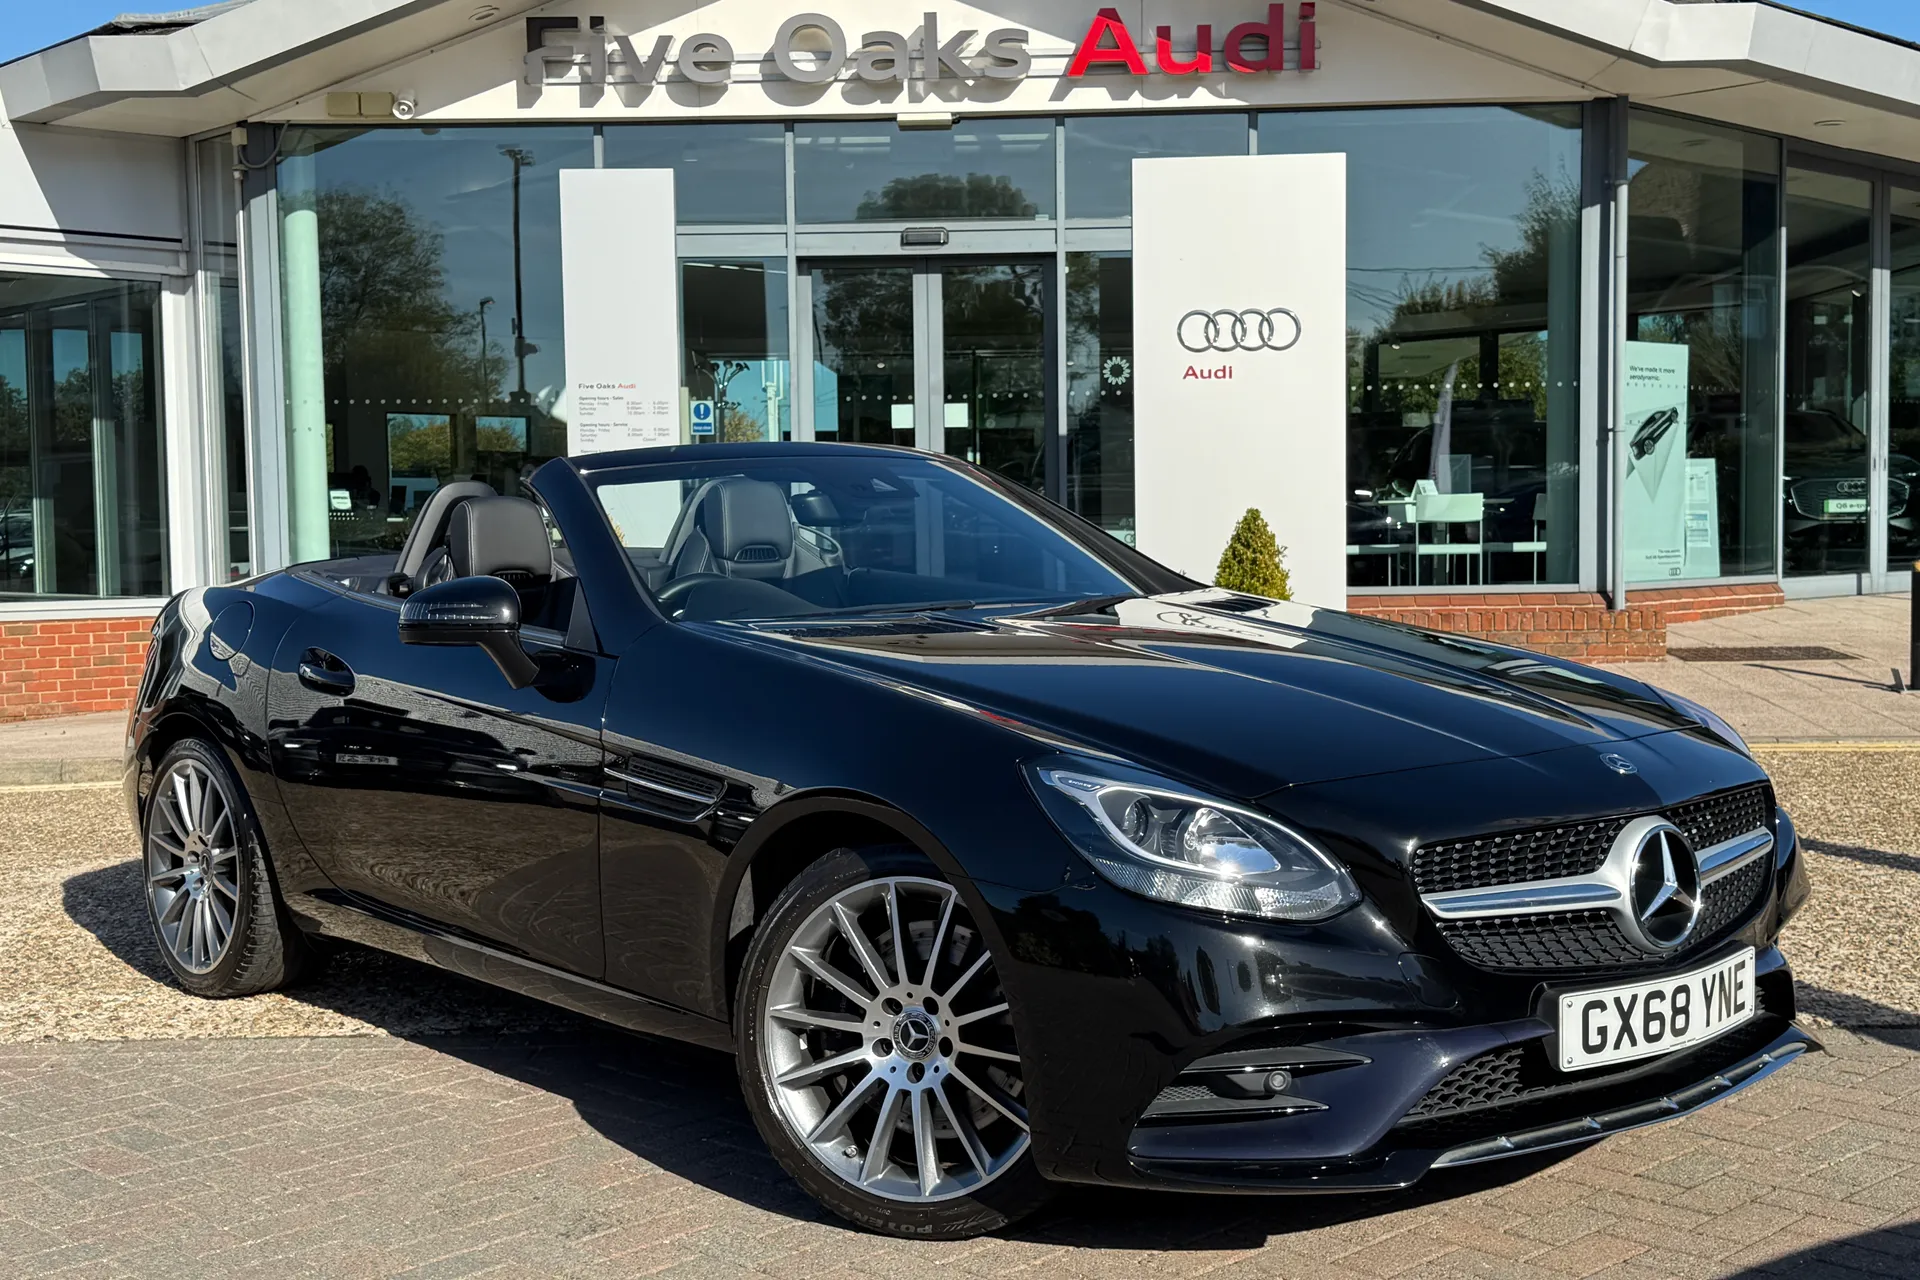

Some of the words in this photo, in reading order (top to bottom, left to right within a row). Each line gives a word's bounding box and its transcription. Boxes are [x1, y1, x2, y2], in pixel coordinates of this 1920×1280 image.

[525, 15, 734, 85] Five
[774, 12, 1032, 83] Oaks
[1067, 2, 1316, 77] Audi
[1182, 365, 1233, 380] Audi
[1581, 983, 1691, 1055] GX68
[1701, 959, 1746, 1029] YNE
